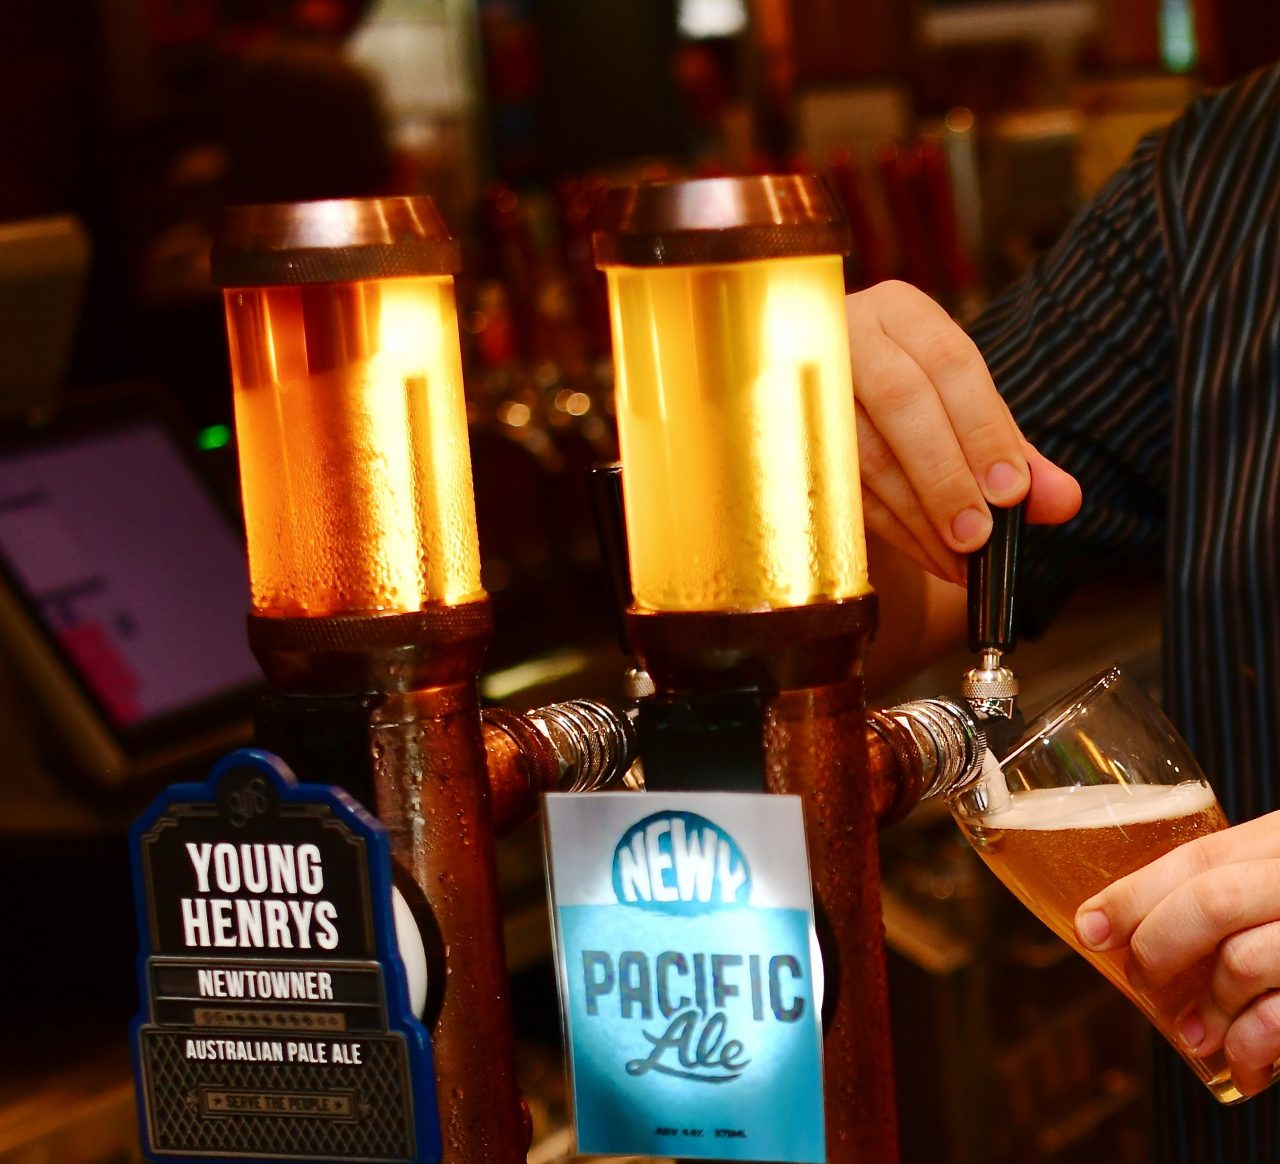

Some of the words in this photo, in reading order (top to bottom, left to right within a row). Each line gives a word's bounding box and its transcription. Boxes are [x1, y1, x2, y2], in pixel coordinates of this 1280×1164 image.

[185, 842, 324, 894] YOUNG
[619, 817, 747, 903] NEWY
[181, 898, 339, 950] HENRYS
[198, 969, 334, 1001] NEWTOWNER
[581, 949, 807, 1023] PACIFIC
[185, 1039, 284, 1063] AUSTRALIAN
[287, 1041, 328, 1065] PALE
[332, 1043, 362, 1065] ALE
[625, 1009, 752, 1083] Ale
[226, 1094, 261, 1110] SERVE
[263, 1096, 286, 1111] THE
